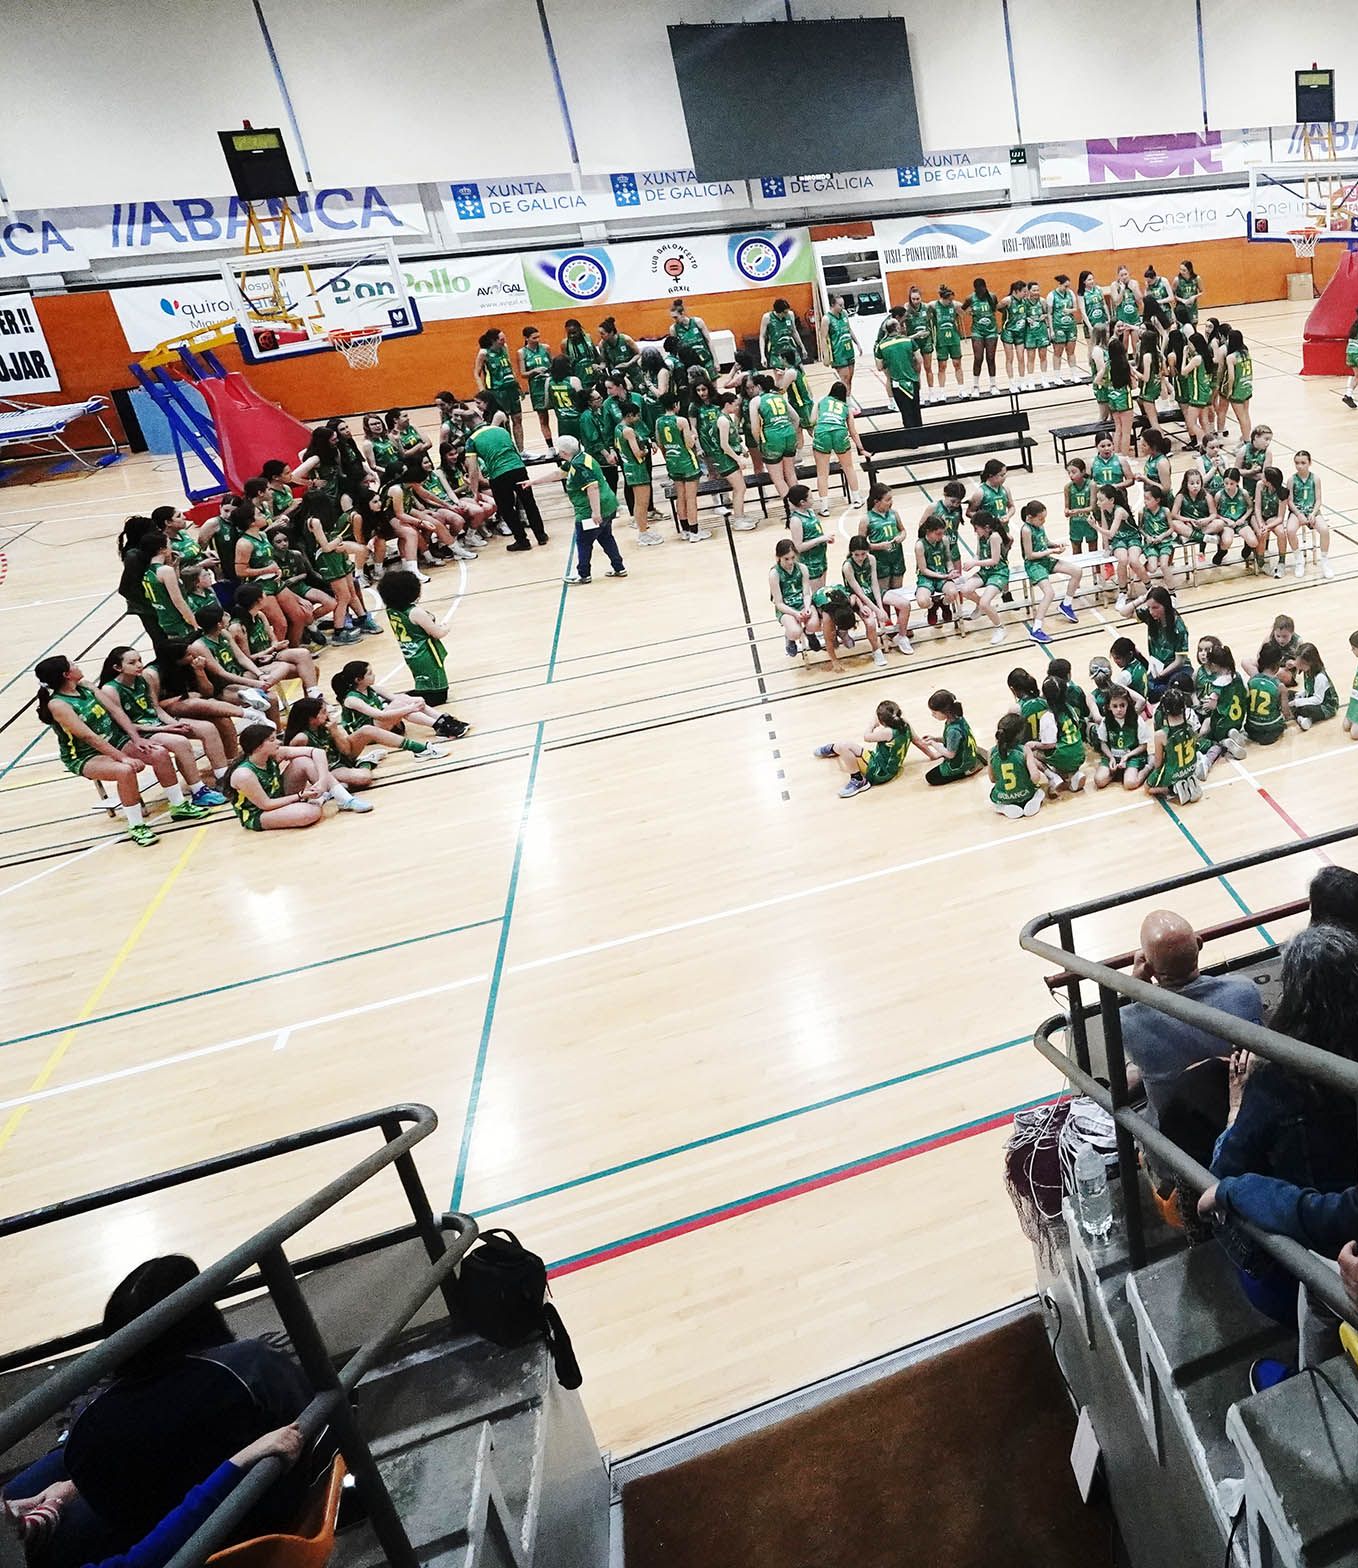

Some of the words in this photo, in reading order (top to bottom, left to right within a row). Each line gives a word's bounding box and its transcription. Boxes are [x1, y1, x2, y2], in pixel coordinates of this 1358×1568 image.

[923, 153, 970, 167] XUNTA
[642, 170, 699, 186] XUNTA
[925, 170, 941, 183] DE
[946, 166, 1001, 180] GALICIA
[487, 182, 547, 198] XUNTA
[645, 189, 664, 202] DE
[670, 184, 734, 198] GALICIA
[791, 180, 810, 193] DE
[816, 177, 874, 191] GALICIA
[490, 201, 512, 214] DE
[518, 195, 587, 212] GALICIA
[140, 186, 403, 247] ABANCA
[0, 220, 74, 258] CA
[330, 277, 396, 304] Bon
[553, 391, 573, 408] 15
[766, 398, 786, 416] 15
[663, 425, 673, 444] 6
[1102, 470, 1112, 481] 11
[1230, 504, 1236, 515] 6
[1248, 689, 1271, 715] 12
[1117, 738, 1124, 749] 6
[1174, 739, 1195, 768] 13
[1001, 762, 1017, 791] 5
